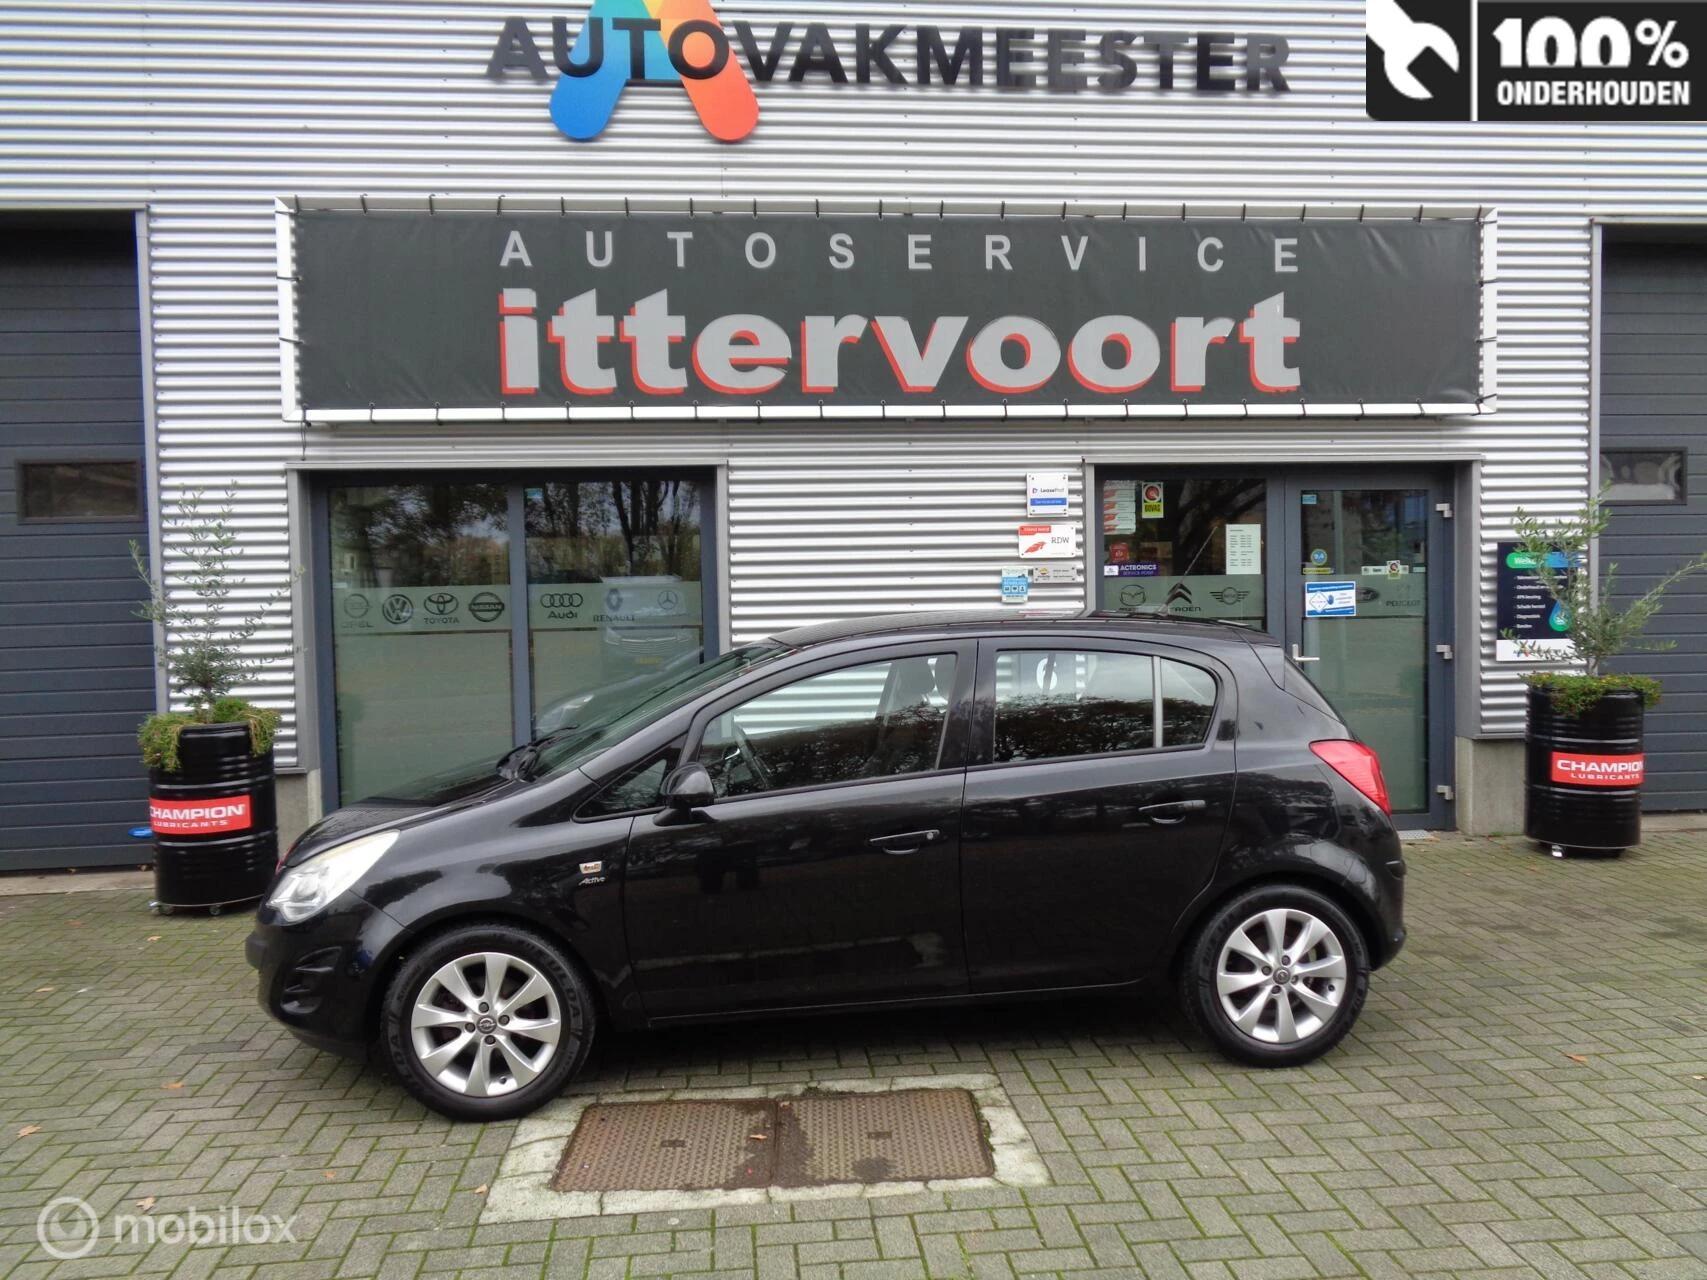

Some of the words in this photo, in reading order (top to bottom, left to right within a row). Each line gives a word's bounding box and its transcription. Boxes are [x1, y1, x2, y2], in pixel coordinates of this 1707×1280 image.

[487, 16, 1291, 92] AUTOVAKMEESTER
[498, 289, 1302, 396] ittervoort
[1051, 536, 1070, 544] RDW
[547, 610, 578, 619] Audi
[423, 617, 460, 625] TOYOTA
[153, 819, 229, 829] LUBRICANTS
